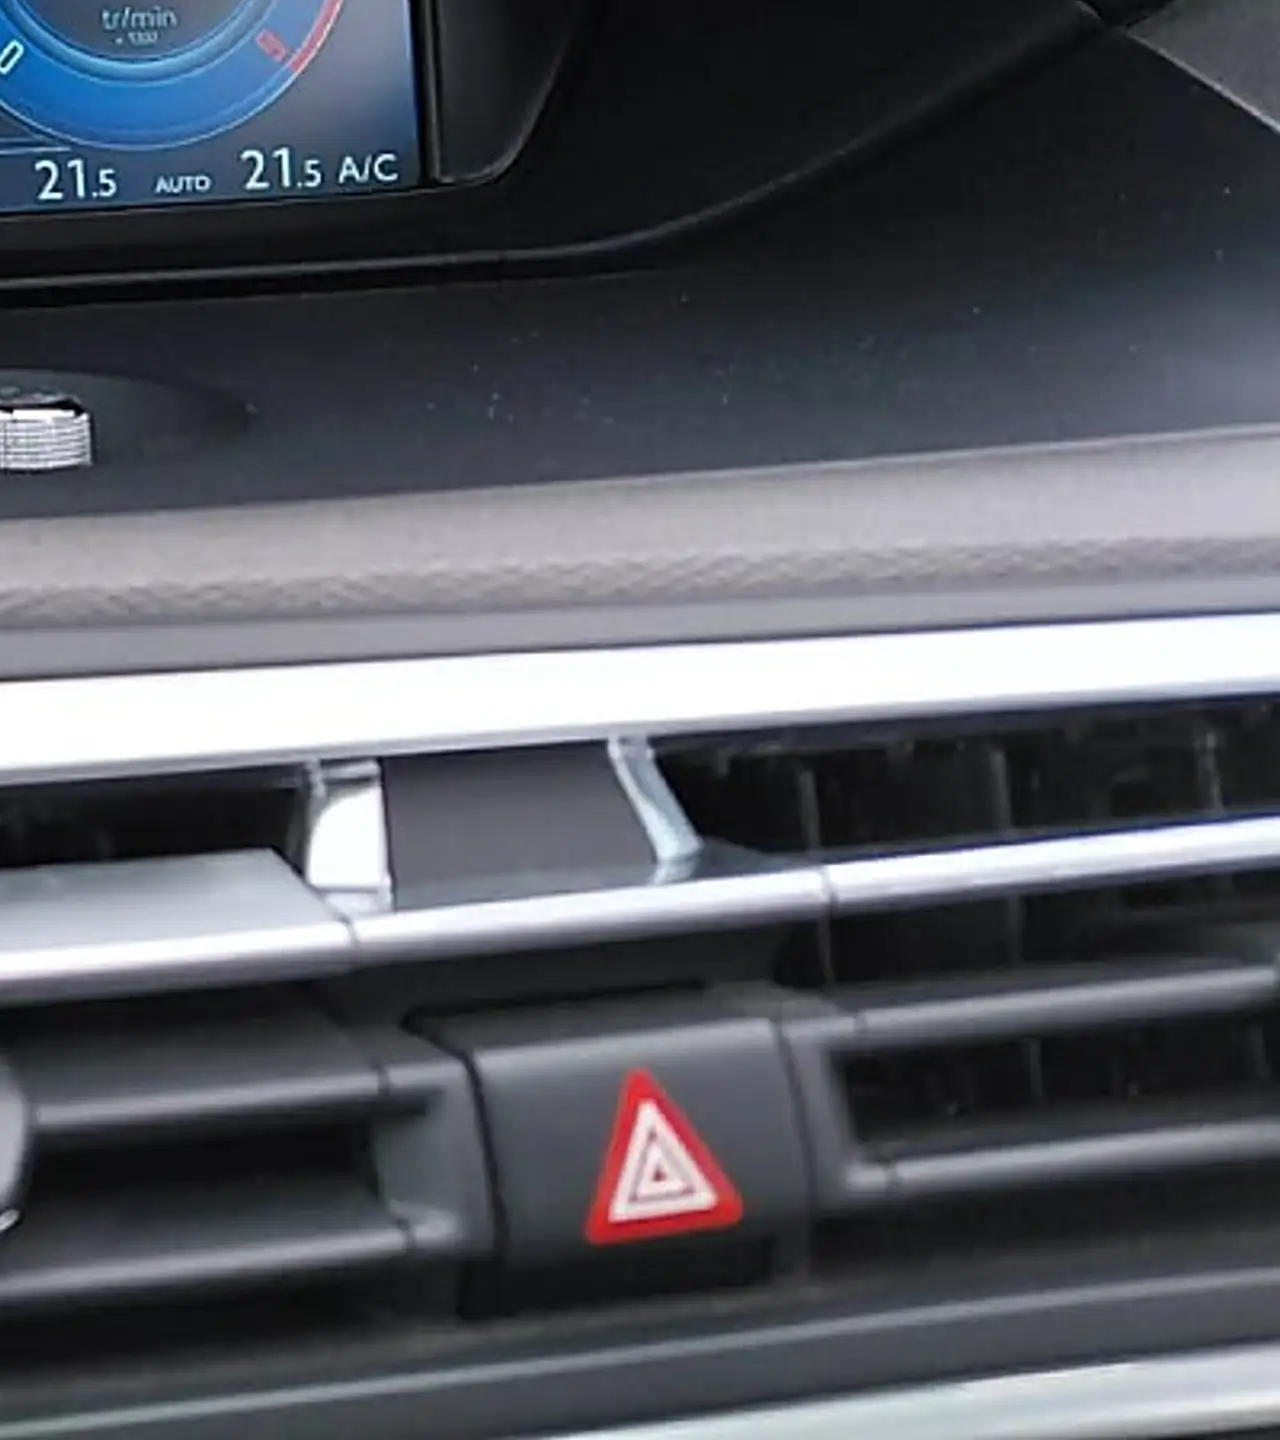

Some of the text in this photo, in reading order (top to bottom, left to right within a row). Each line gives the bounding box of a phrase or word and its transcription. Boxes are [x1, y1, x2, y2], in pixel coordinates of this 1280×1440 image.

[102, 5, 178, 30] tr/min
[34, 147, 399, 201] 21.5 AUTO 21.5 A/C
